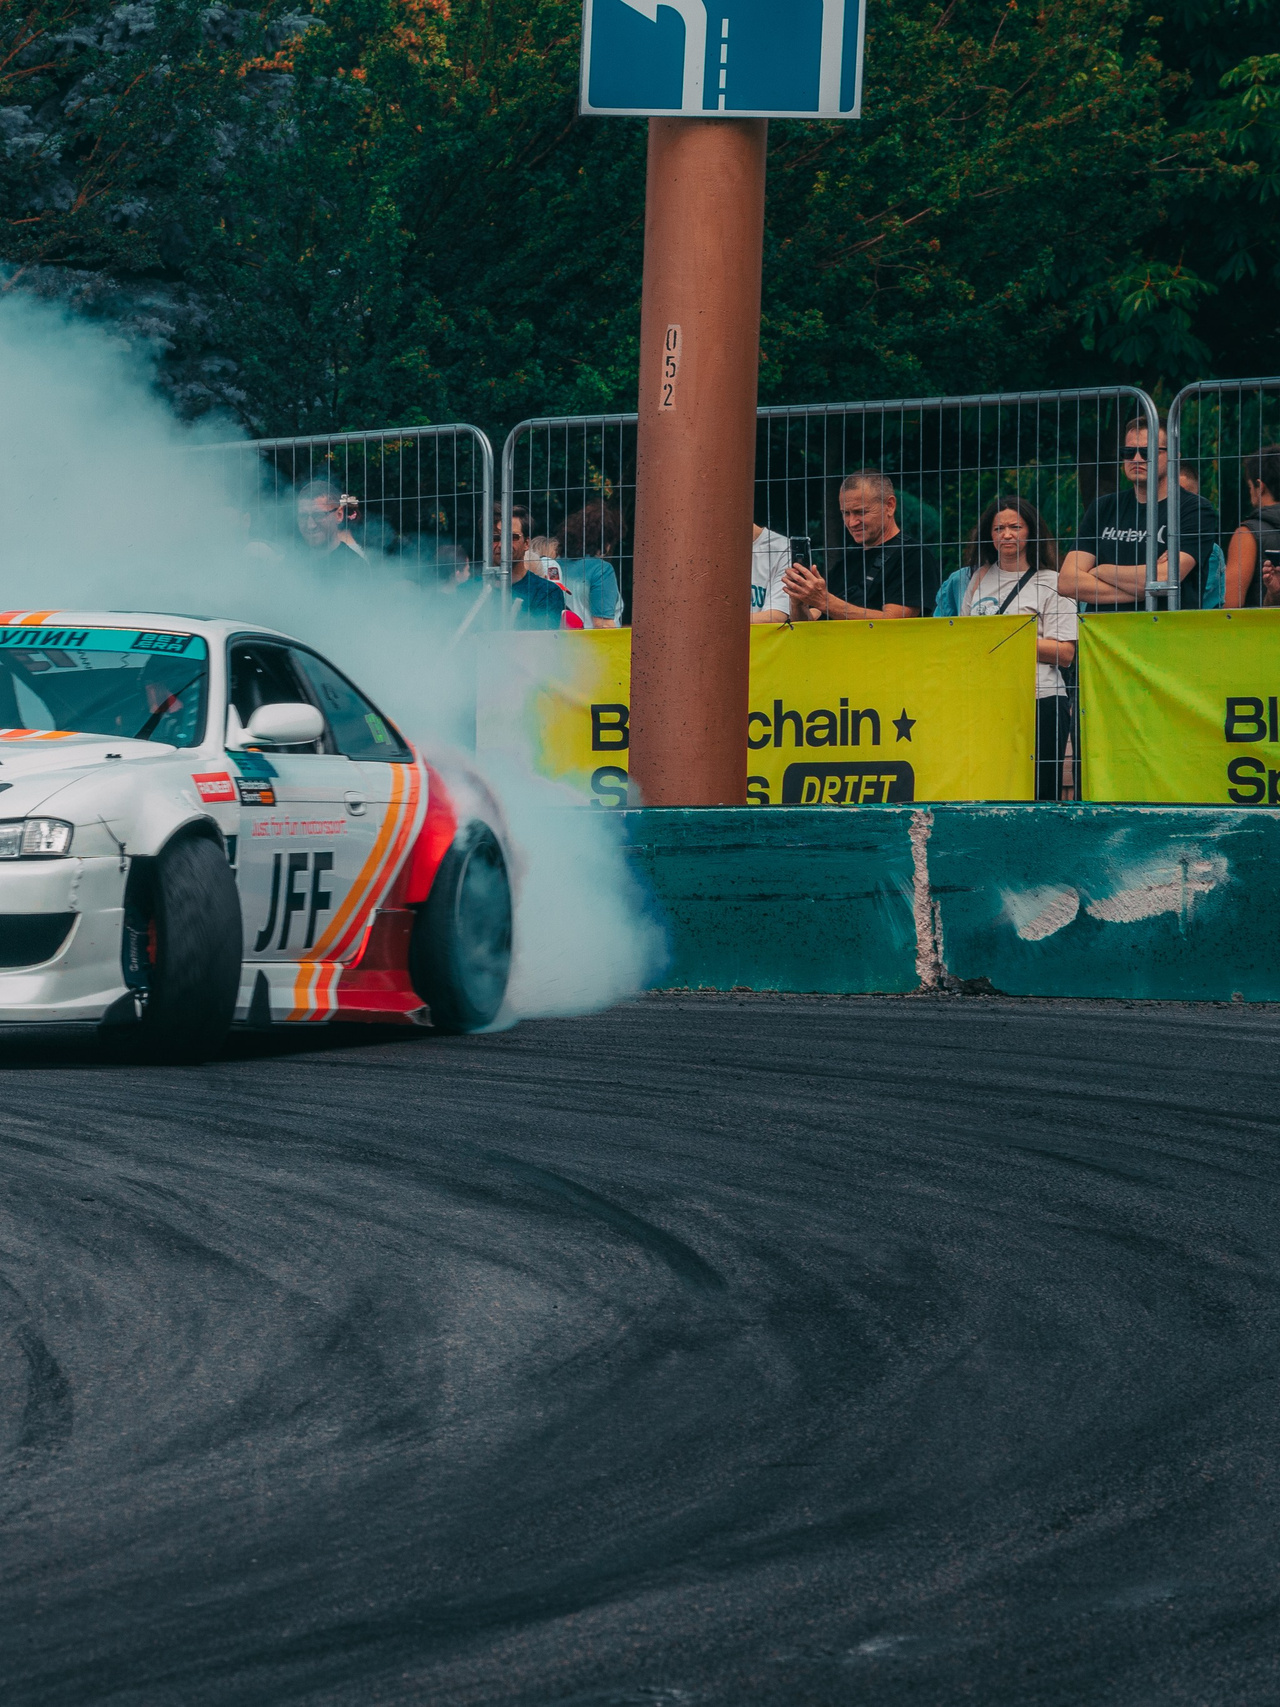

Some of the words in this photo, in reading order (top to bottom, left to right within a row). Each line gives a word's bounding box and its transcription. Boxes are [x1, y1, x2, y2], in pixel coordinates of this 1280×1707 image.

[663, 328, 678, 407] 052
[1101, 526, 1148, 543] Hurley
[801, 775, 898, 804] DRIFT
[253, 852, 334, 952] JFF
